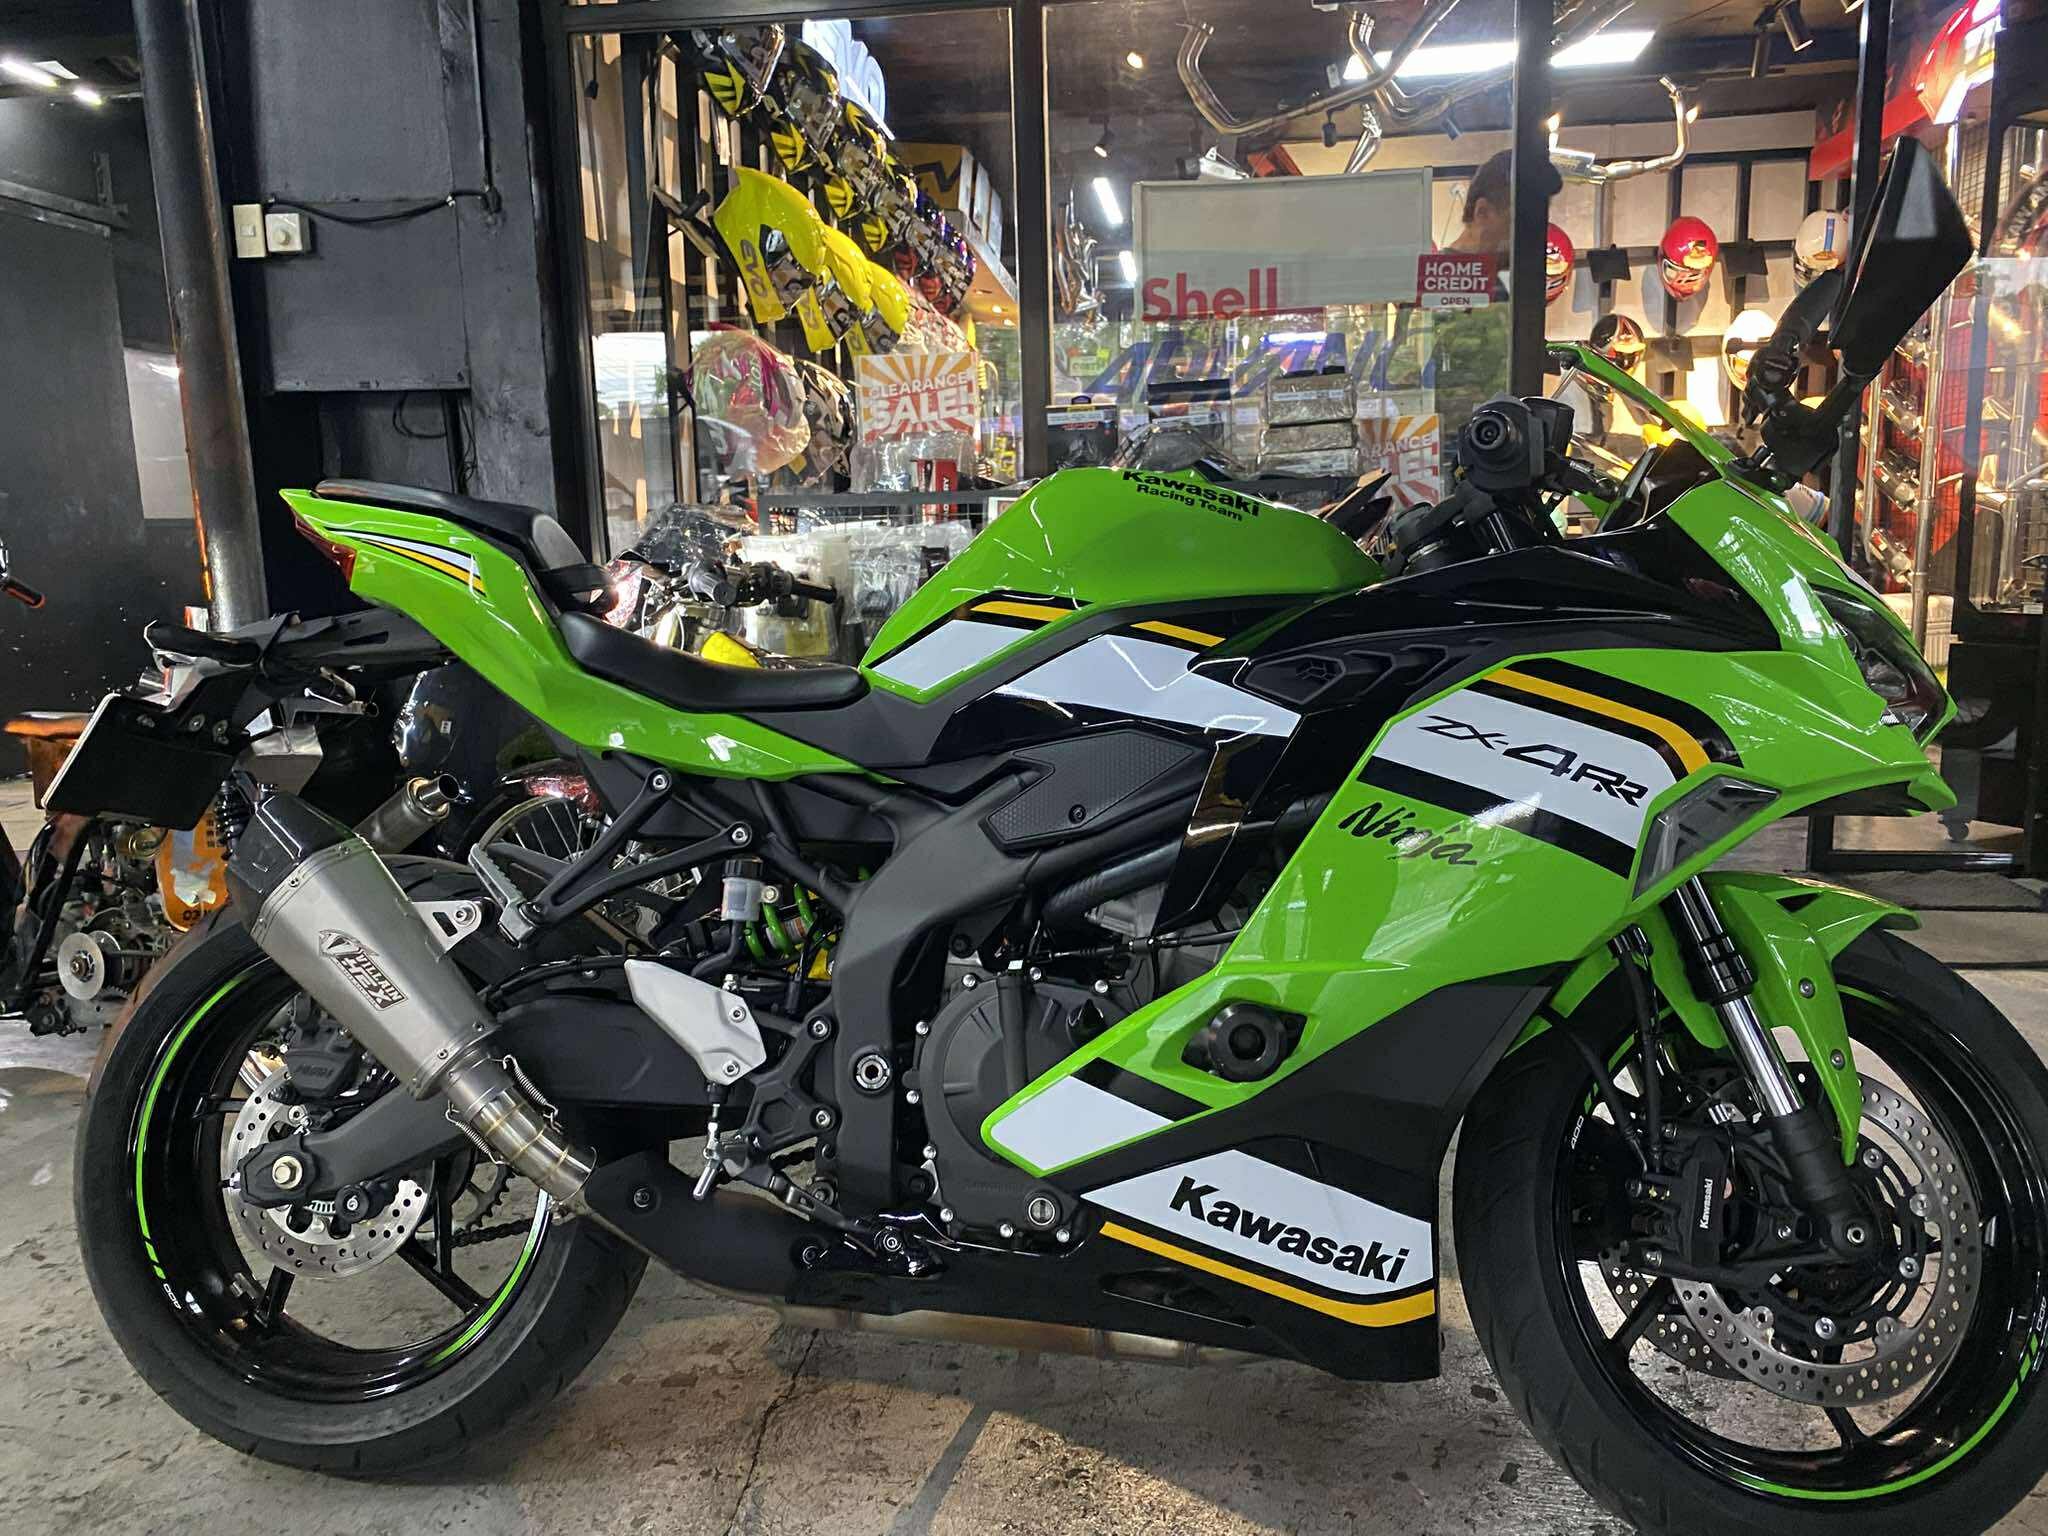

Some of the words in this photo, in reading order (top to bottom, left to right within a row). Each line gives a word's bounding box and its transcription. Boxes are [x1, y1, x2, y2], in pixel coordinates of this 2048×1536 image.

[1424, 276, 1488, 291] CREDIT
[1425, 262, 1482, 276] HOME
[1141, 267, 1279, 323] Shell
[1440, 296, 1470, 306] OPEN
[869, 372, 969, 398] CLEARANCE
[869, 385, 970, 431] SALE!
[1122, 470, 1260, 517] Kawasaki
[1136, 483, 1195, 506] Racing
[1199, 499, 1243, 521] Team
[1417, 715, 1649, 808] ZX-4RR
[1338, 801, 1478, 867] Ninja
[341, 956, 393, 1005] HEX
[355, 954, 402, 1001] VILLAIN
[1699, 1178, 1713, 1229] Kawasaki
[1168, 1175, 1410, 1283] Kawasaki
